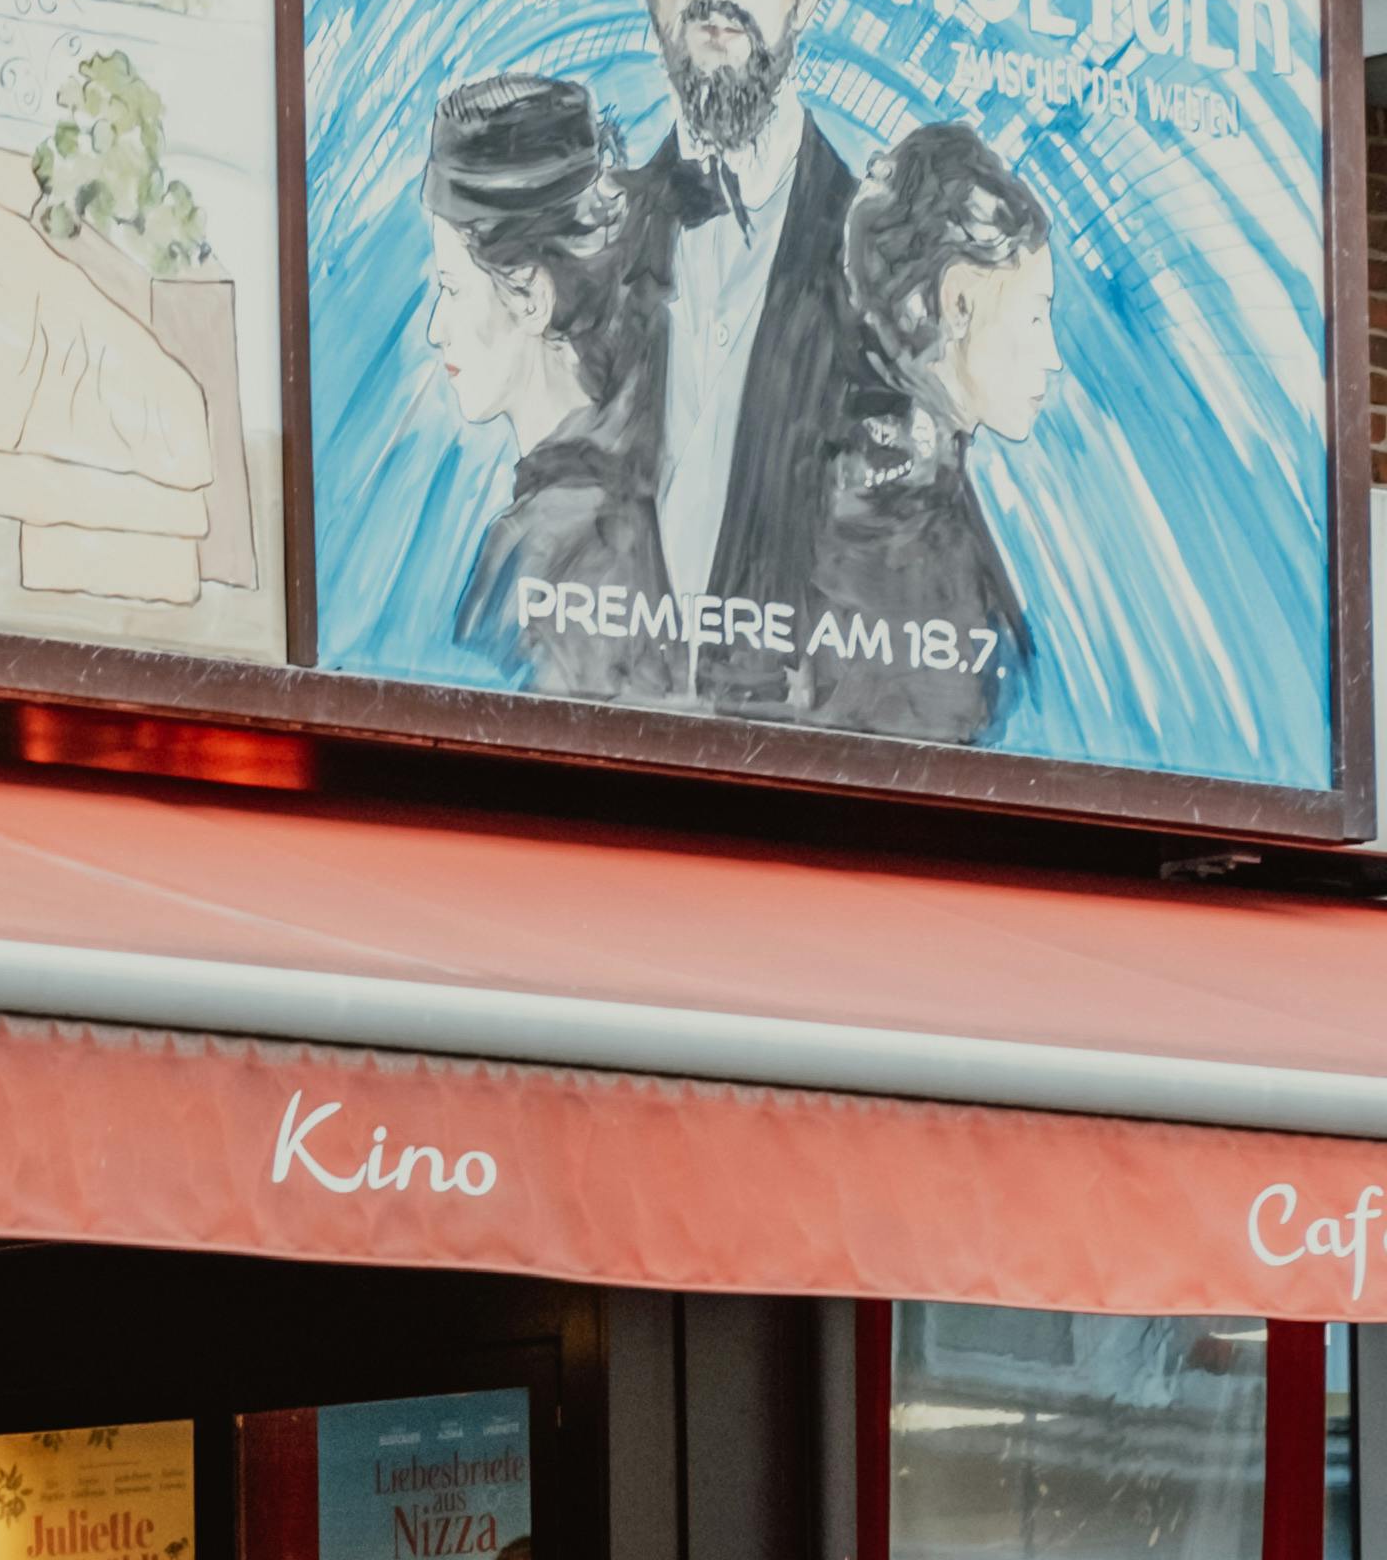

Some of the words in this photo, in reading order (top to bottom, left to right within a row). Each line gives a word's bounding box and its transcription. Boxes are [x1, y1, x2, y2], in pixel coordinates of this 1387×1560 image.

[517, 577, 795, 654] PREMIERE
[806, 611, 893, 666] AM
[904, 618, 1007, 680] 18.7.
[272, 1090, 497, 1197] Kino
[1248, 1183, 1387, 1301] Caf
[374, 1444, 524, 1495] Liebesbriefe
[394, 1502, 497, 1560] Nizza
[433, 1490, 467, 1515] aus
[27, 1509, 154, 1558] Juliette
